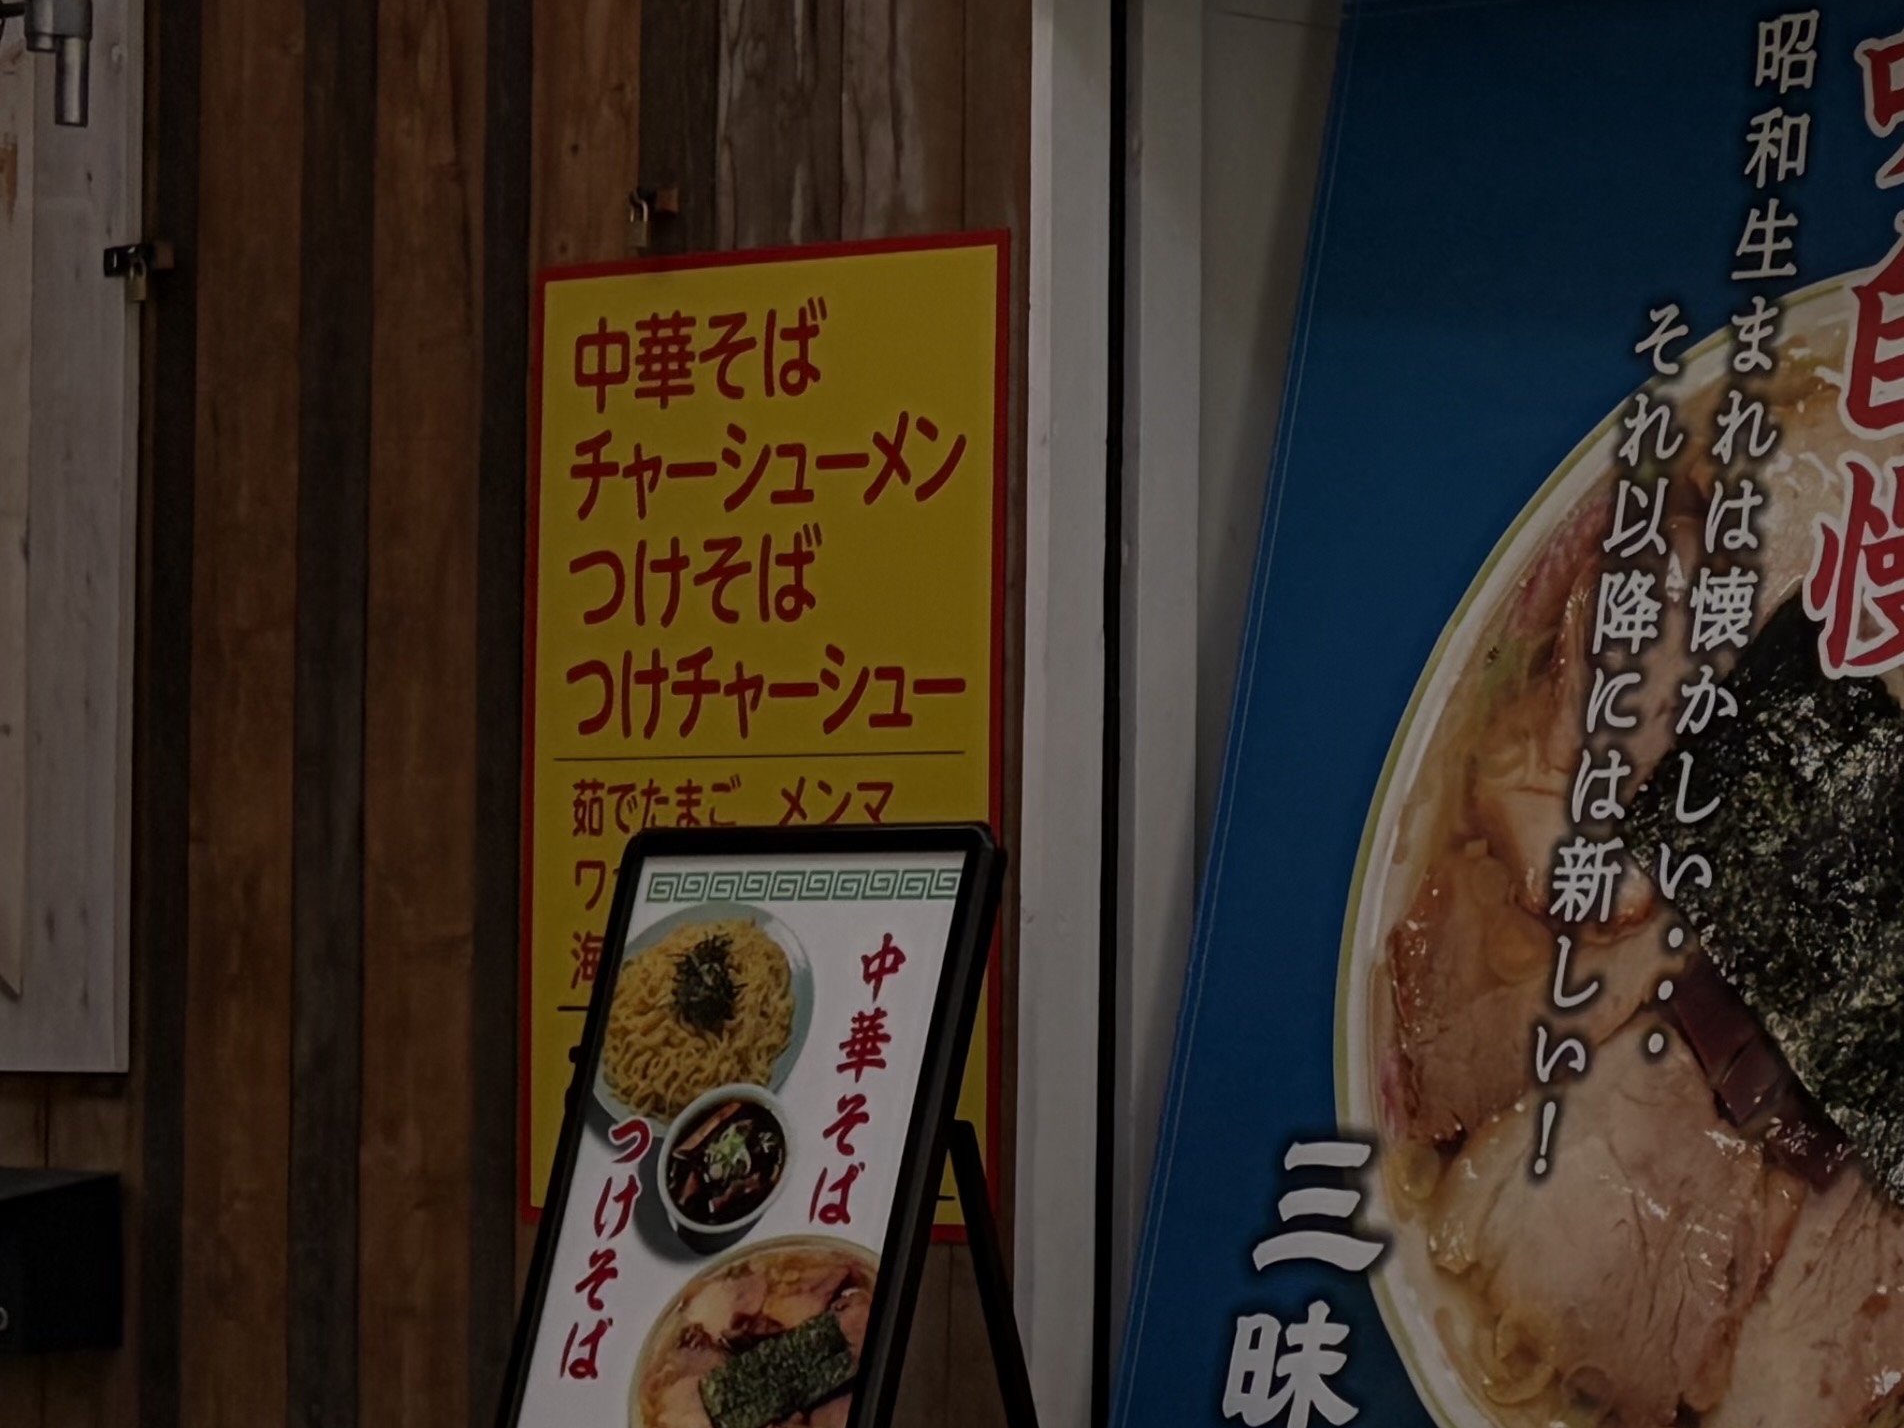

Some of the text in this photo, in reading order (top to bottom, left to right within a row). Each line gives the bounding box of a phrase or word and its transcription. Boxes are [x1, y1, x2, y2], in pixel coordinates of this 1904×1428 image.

[574, 296, 828, 414] 中華そば
[570, 410, 967, 521] チャーシューメン
[569, 522, 823, 628] つけそば
[566, 644, 967, 741] つけチャーシュー
[779, 775, 895, 827] メンマ
[809, 931, 907, 1227] 中華そば
[559, 1117, 652, 1381] つけそば
